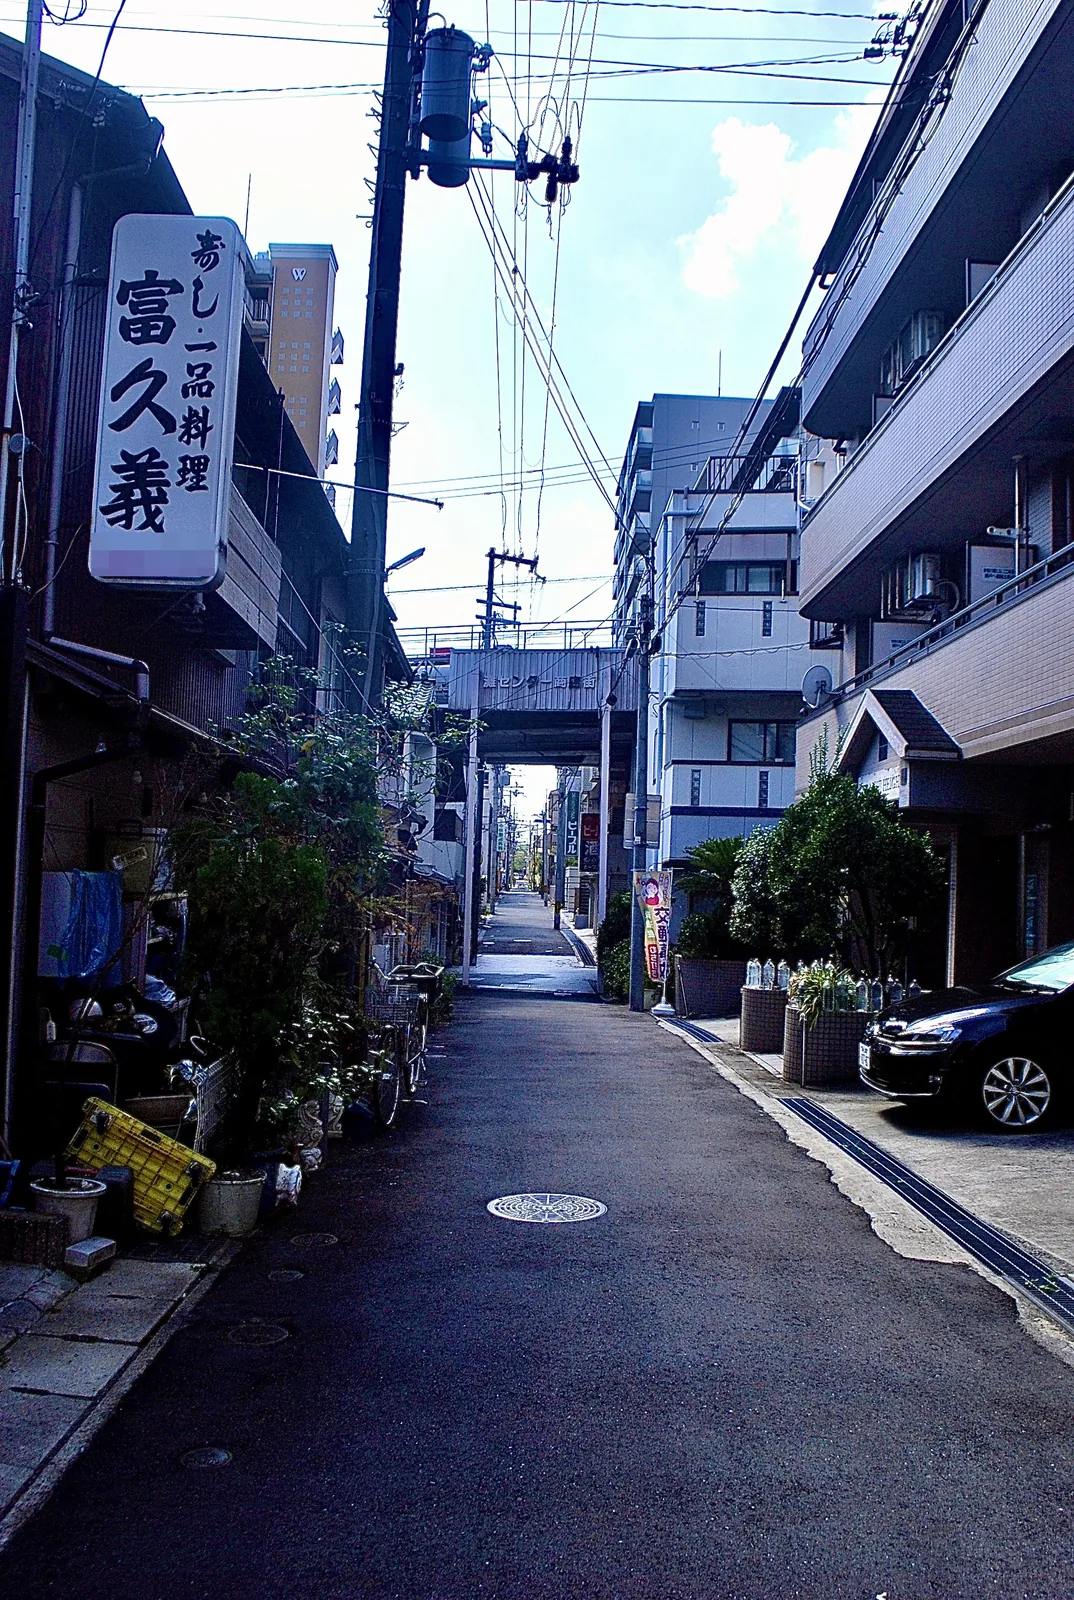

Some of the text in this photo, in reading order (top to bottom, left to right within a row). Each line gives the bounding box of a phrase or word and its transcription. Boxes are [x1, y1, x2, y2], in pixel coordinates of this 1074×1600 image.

[99, 269, 185, 533] 富久義
[483, 675, 596, 689] 灘センター商店街
